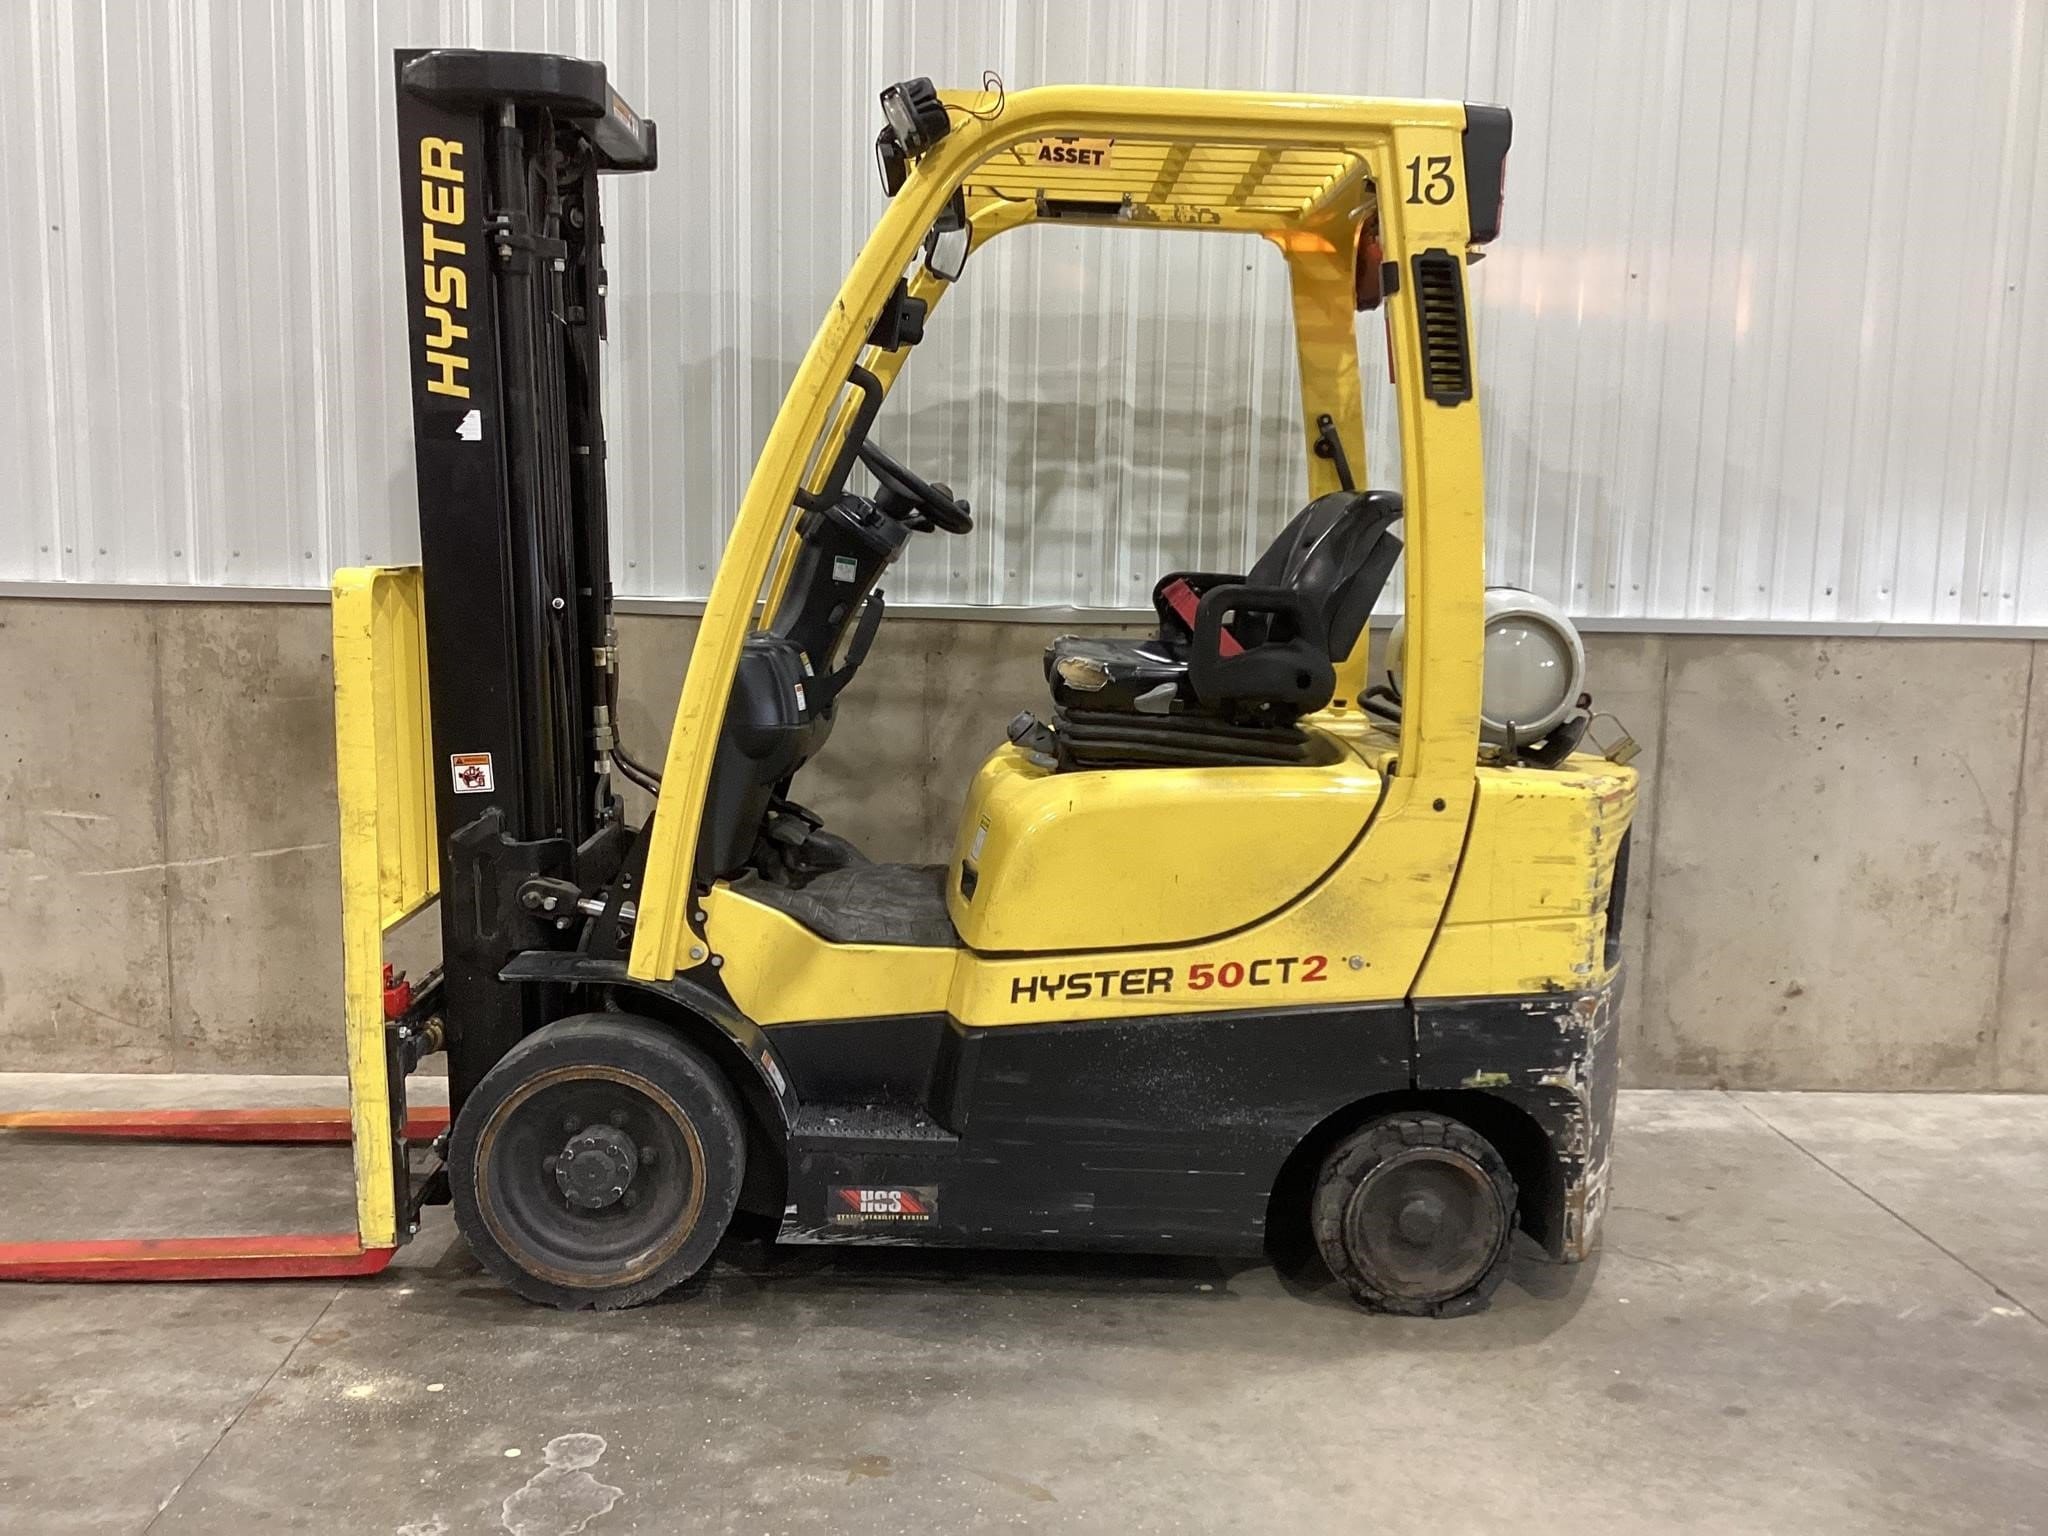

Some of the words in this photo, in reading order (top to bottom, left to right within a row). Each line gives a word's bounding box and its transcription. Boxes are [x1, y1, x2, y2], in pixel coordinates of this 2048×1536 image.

[1039, 145, 1104, 166] ASSET
[1406, 155, 1454, 205] 13
[420, 136, 470, 399] HYSTER
[1010, 966, 1174, 1004] HYSTER
[1187, 955, 1328, 991] 50CT2
